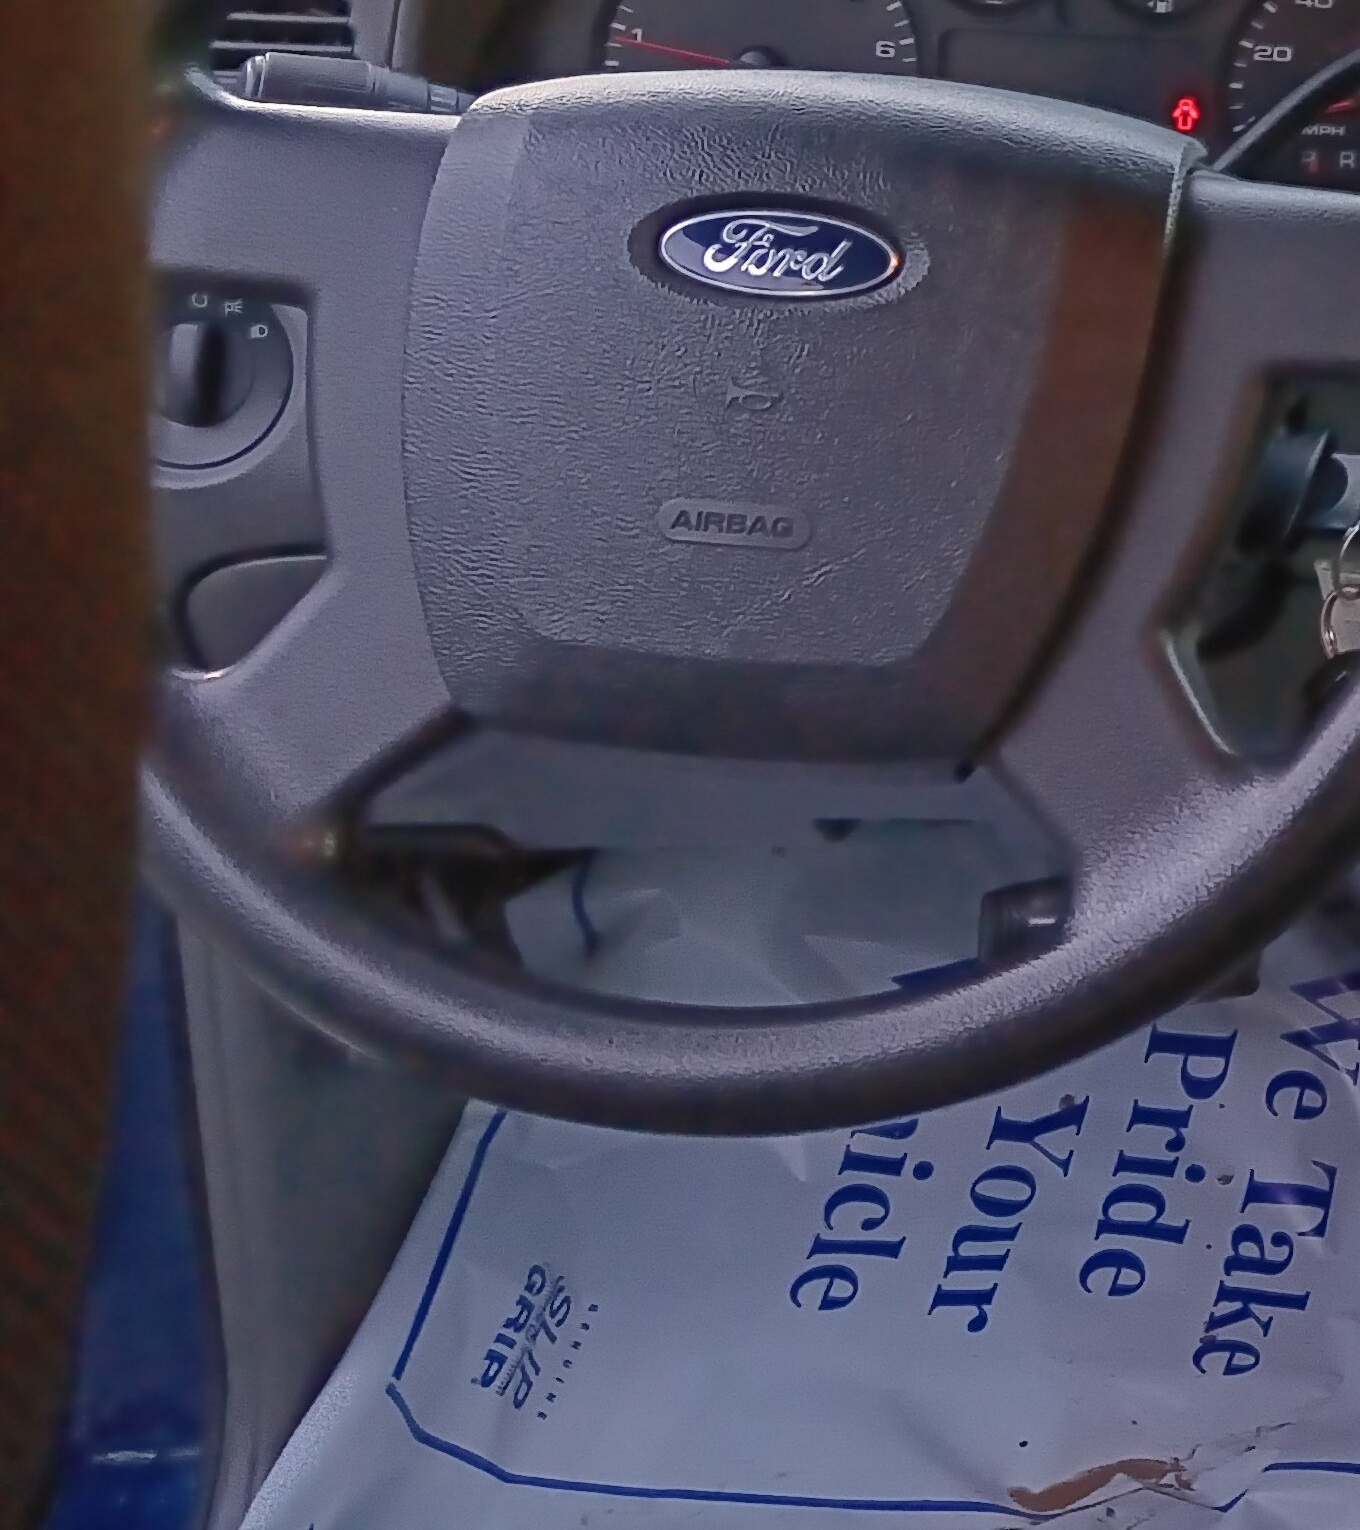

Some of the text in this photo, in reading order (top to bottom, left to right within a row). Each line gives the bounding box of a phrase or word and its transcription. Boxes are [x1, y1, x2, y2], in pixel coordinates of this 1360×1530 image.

[632, 28, 643, 43] 1
[875, 40, 895, 58] 6
[1253, 45, 1293, 62] 20
[704, 219, 853, 283] Ford
[669, 510, 795, 537] AIRBAG
[1079, 1023, 1238, 1298] Pride
[790, 1118, 934, 1312] icle
[927, 1095, 1090, 1333] Your
[1192, 1160, 1338, 1377] Take
[480, 1264, 547, 1388] GRIP
